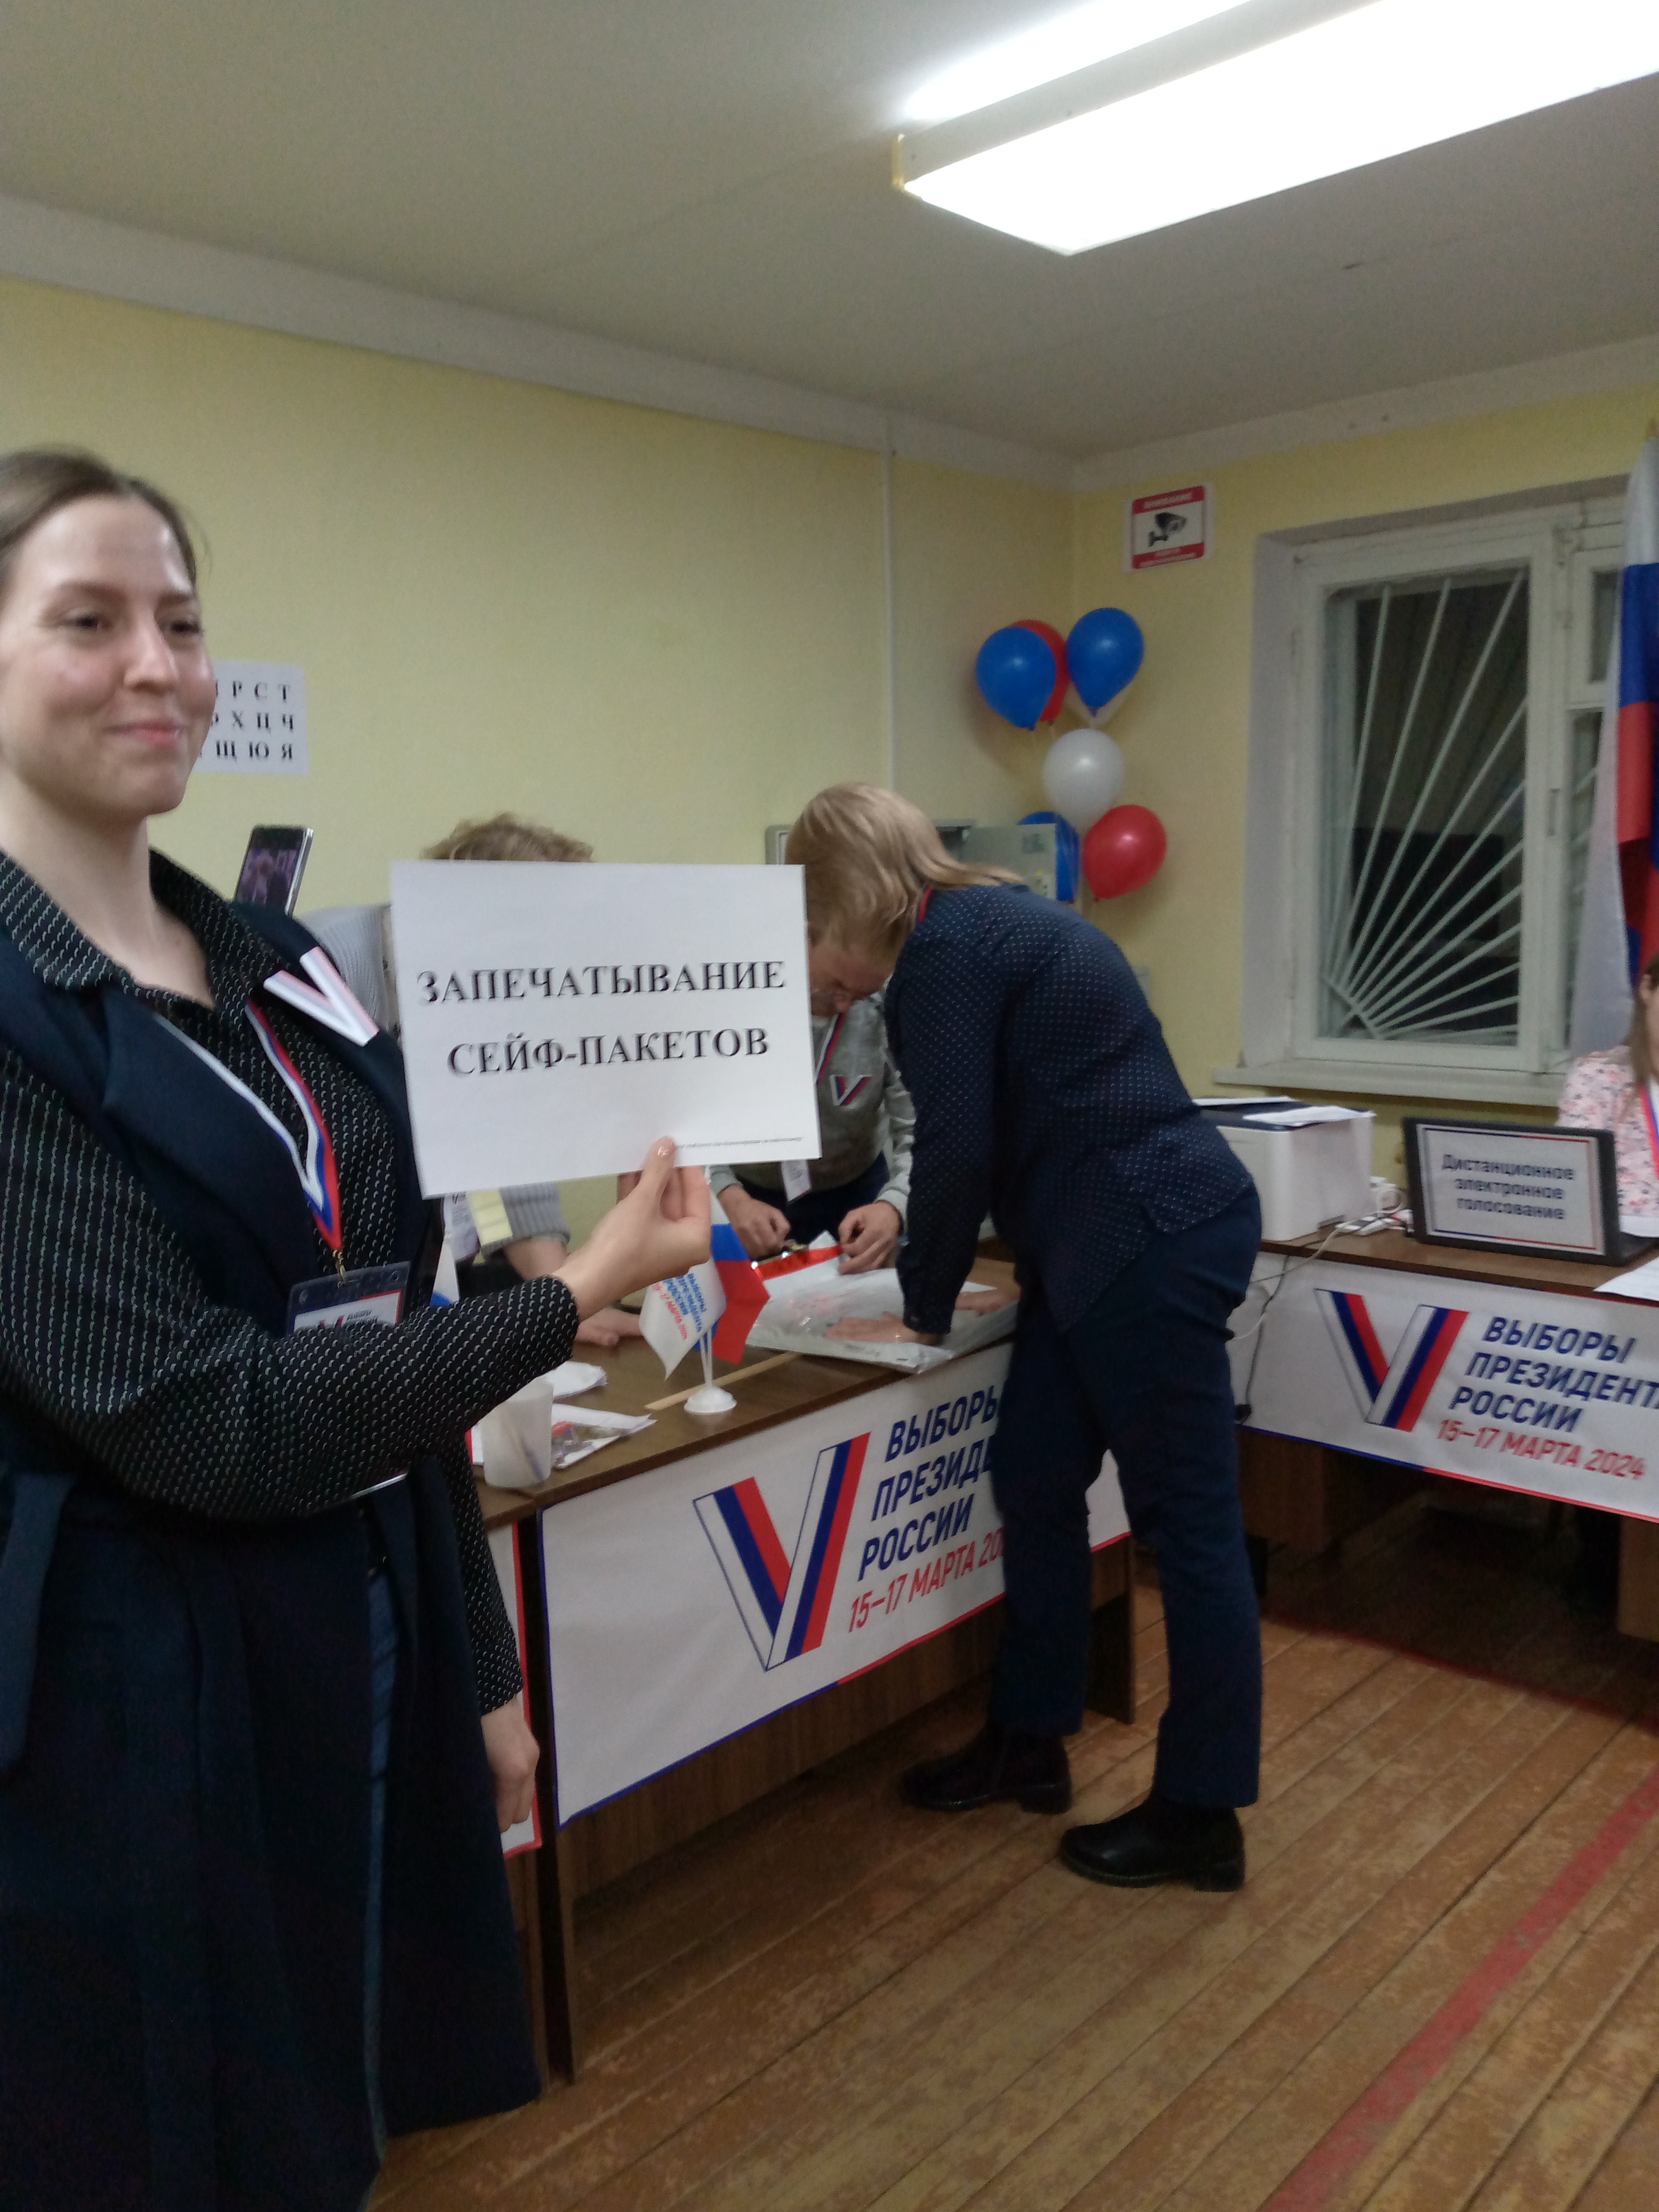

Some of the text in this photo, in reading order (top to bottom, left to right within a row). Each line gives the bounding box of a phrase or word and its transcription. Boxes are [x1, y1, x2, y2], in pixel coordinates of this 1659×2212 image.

[416, 960, 786, 1005] ЗАПЕЧАТЫВАНИЕ
[447, 1027, 770, 1077] СЕЙФ-ПАКЕТОВ
[1442, 1153, 1575, 1180] Дистанционное
[1454, 1178, 1565, 1200] электронное
[1456, 1197, 1565, 1220] голосование
[1481, 1316, 1637, 1364] ВЫБОРЫ
[1464, 1351, 1659, 1410] ПРЕЗИДЕНТ
[1448, 1386, 1585, 1432] РОССИИ
[1499, 1431, 1583, 1468] МАРТА
[1583, 1448, 1646, 1480] 2024
[857, 1493, 975, 1582] РОССИИ
[907, 1540, 976, 1604] МАРТА
